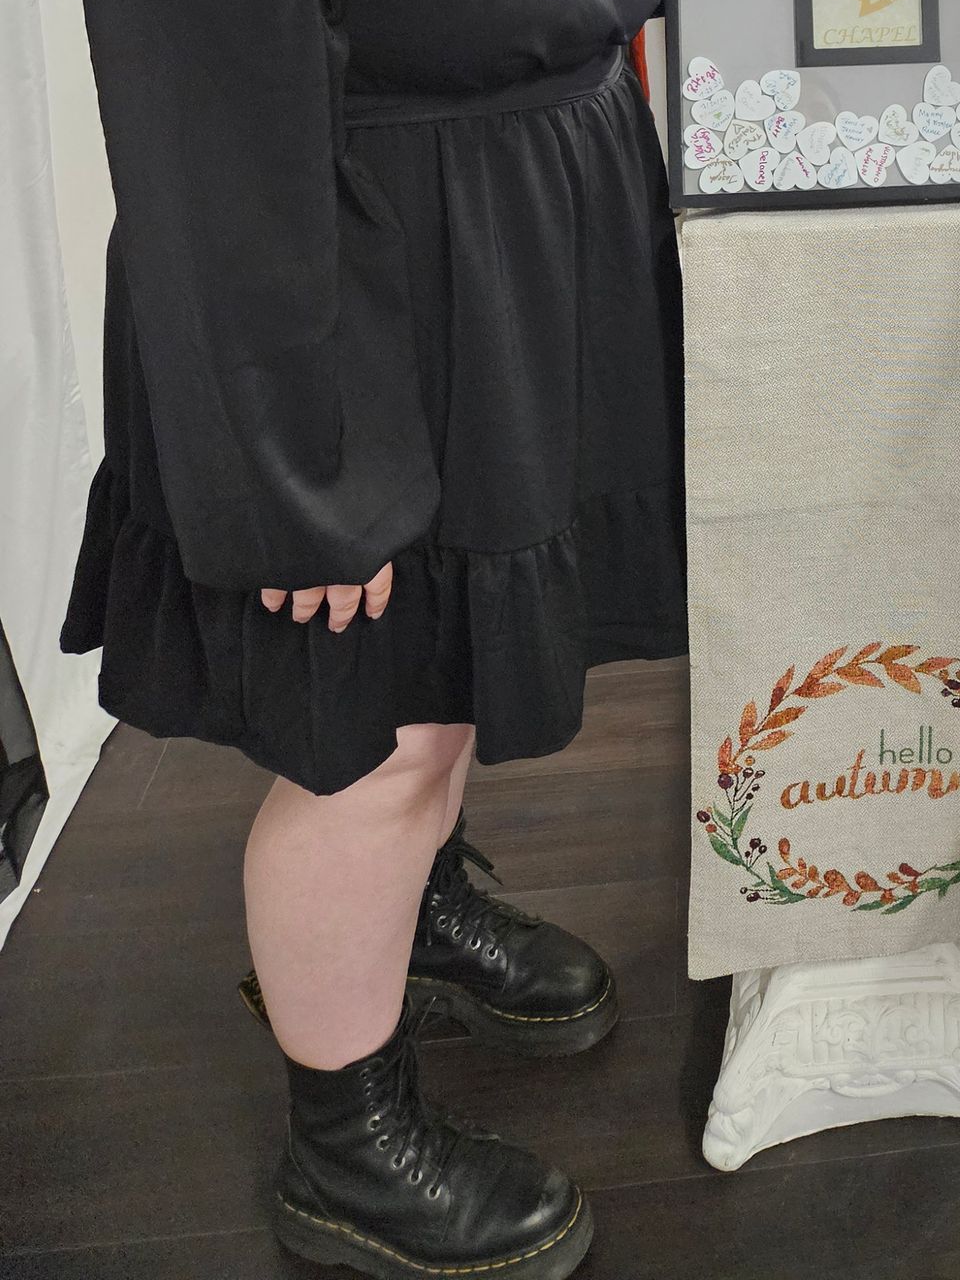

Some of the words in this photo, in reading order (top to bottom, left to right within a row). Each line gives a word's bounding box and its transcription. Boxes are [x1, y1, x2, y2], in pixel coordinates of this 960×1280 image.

[823, 25, 917, 46] CHAPEL
[754, 150, 769, 185] Delaney
[879, 725, 953, 766] hello
